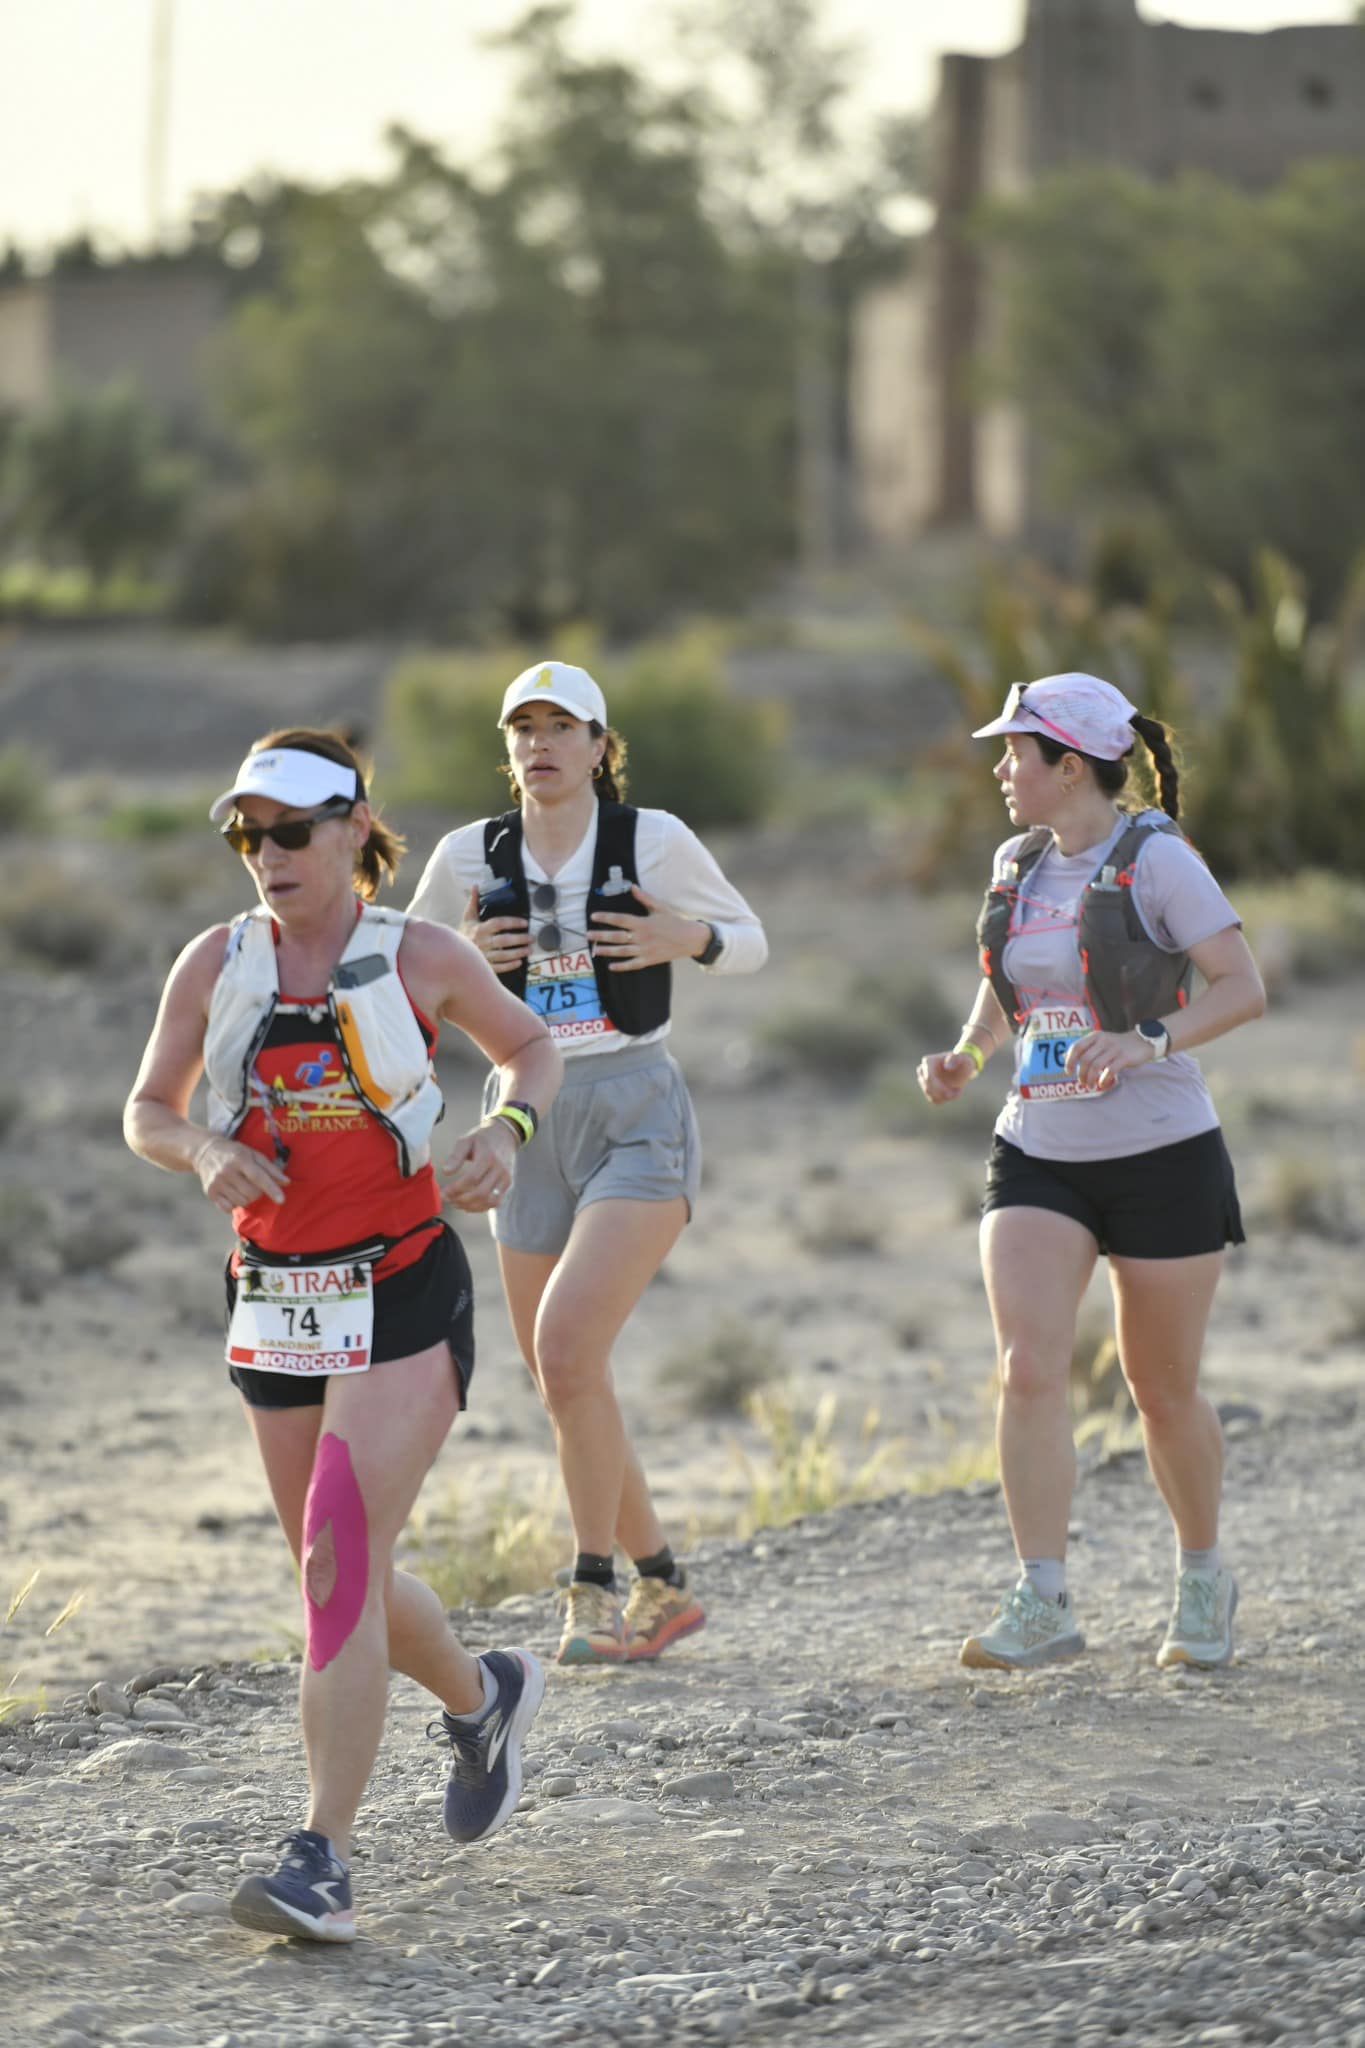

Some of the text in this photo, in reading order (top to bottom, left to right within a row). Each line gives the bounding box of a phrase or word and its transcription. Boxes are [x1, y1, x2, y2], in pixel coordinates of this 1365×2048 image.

[549, 953, 590, 973] TRA
[539, 982, 577, 1011] 75
[550, 1020, 605, 1038] ROCCO
[1043, 1010, 1089, 1030] TRA
[1038, 1041, 1067, 1069] 76
[281, 1306, 321, 1337] 74
[253, 1351, 350, 1371] MOROCCO
